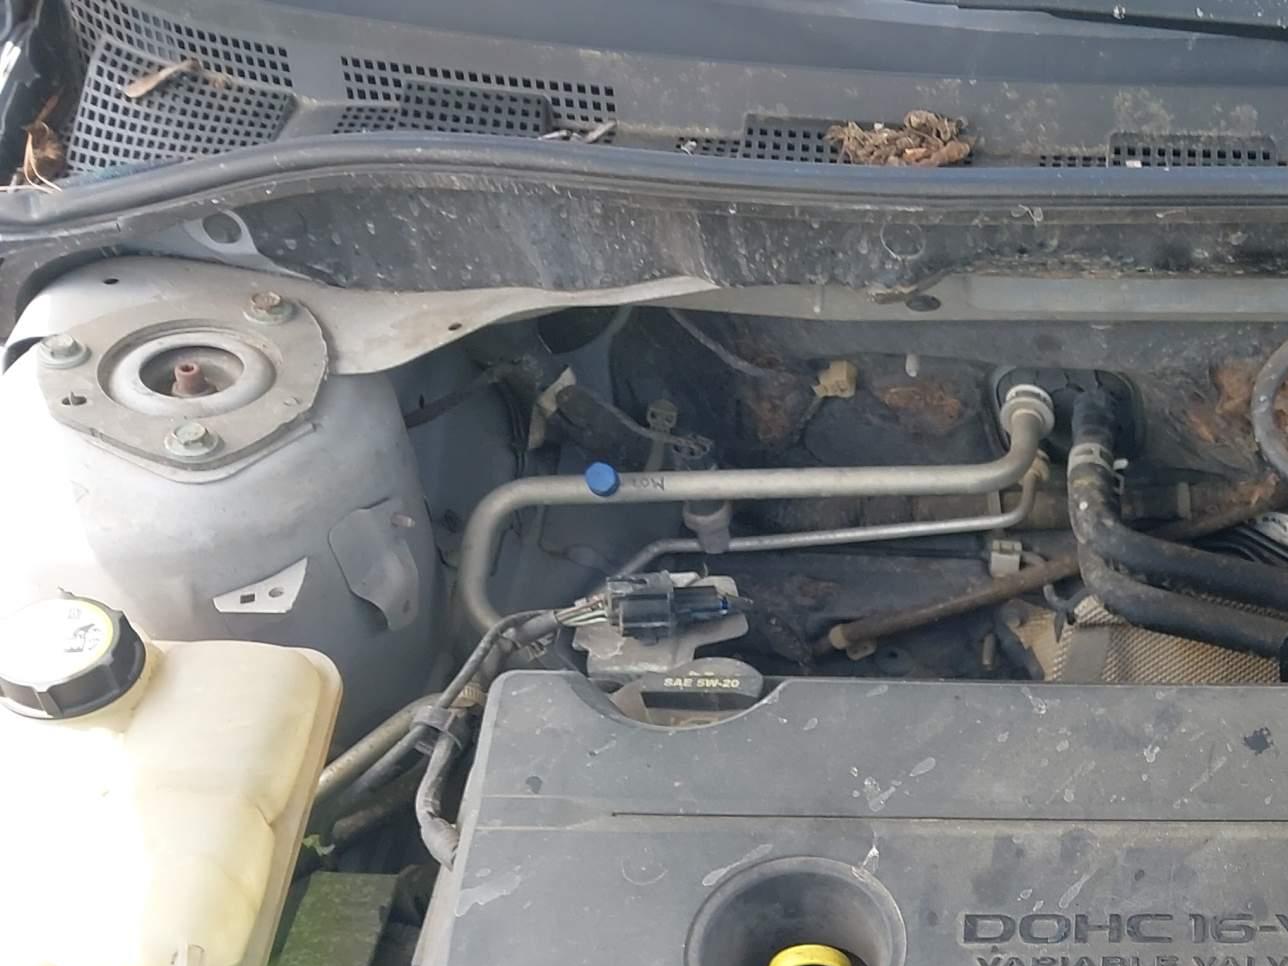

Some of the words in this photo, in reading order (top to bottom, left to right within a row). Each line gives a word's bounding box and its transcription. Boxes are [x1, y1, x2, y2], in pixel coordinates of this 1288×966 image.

[664, 678, 693, 689] SAE
[696, 678, 740, 689] 5W-20
[963, 913, 1174, 944] DOHC
